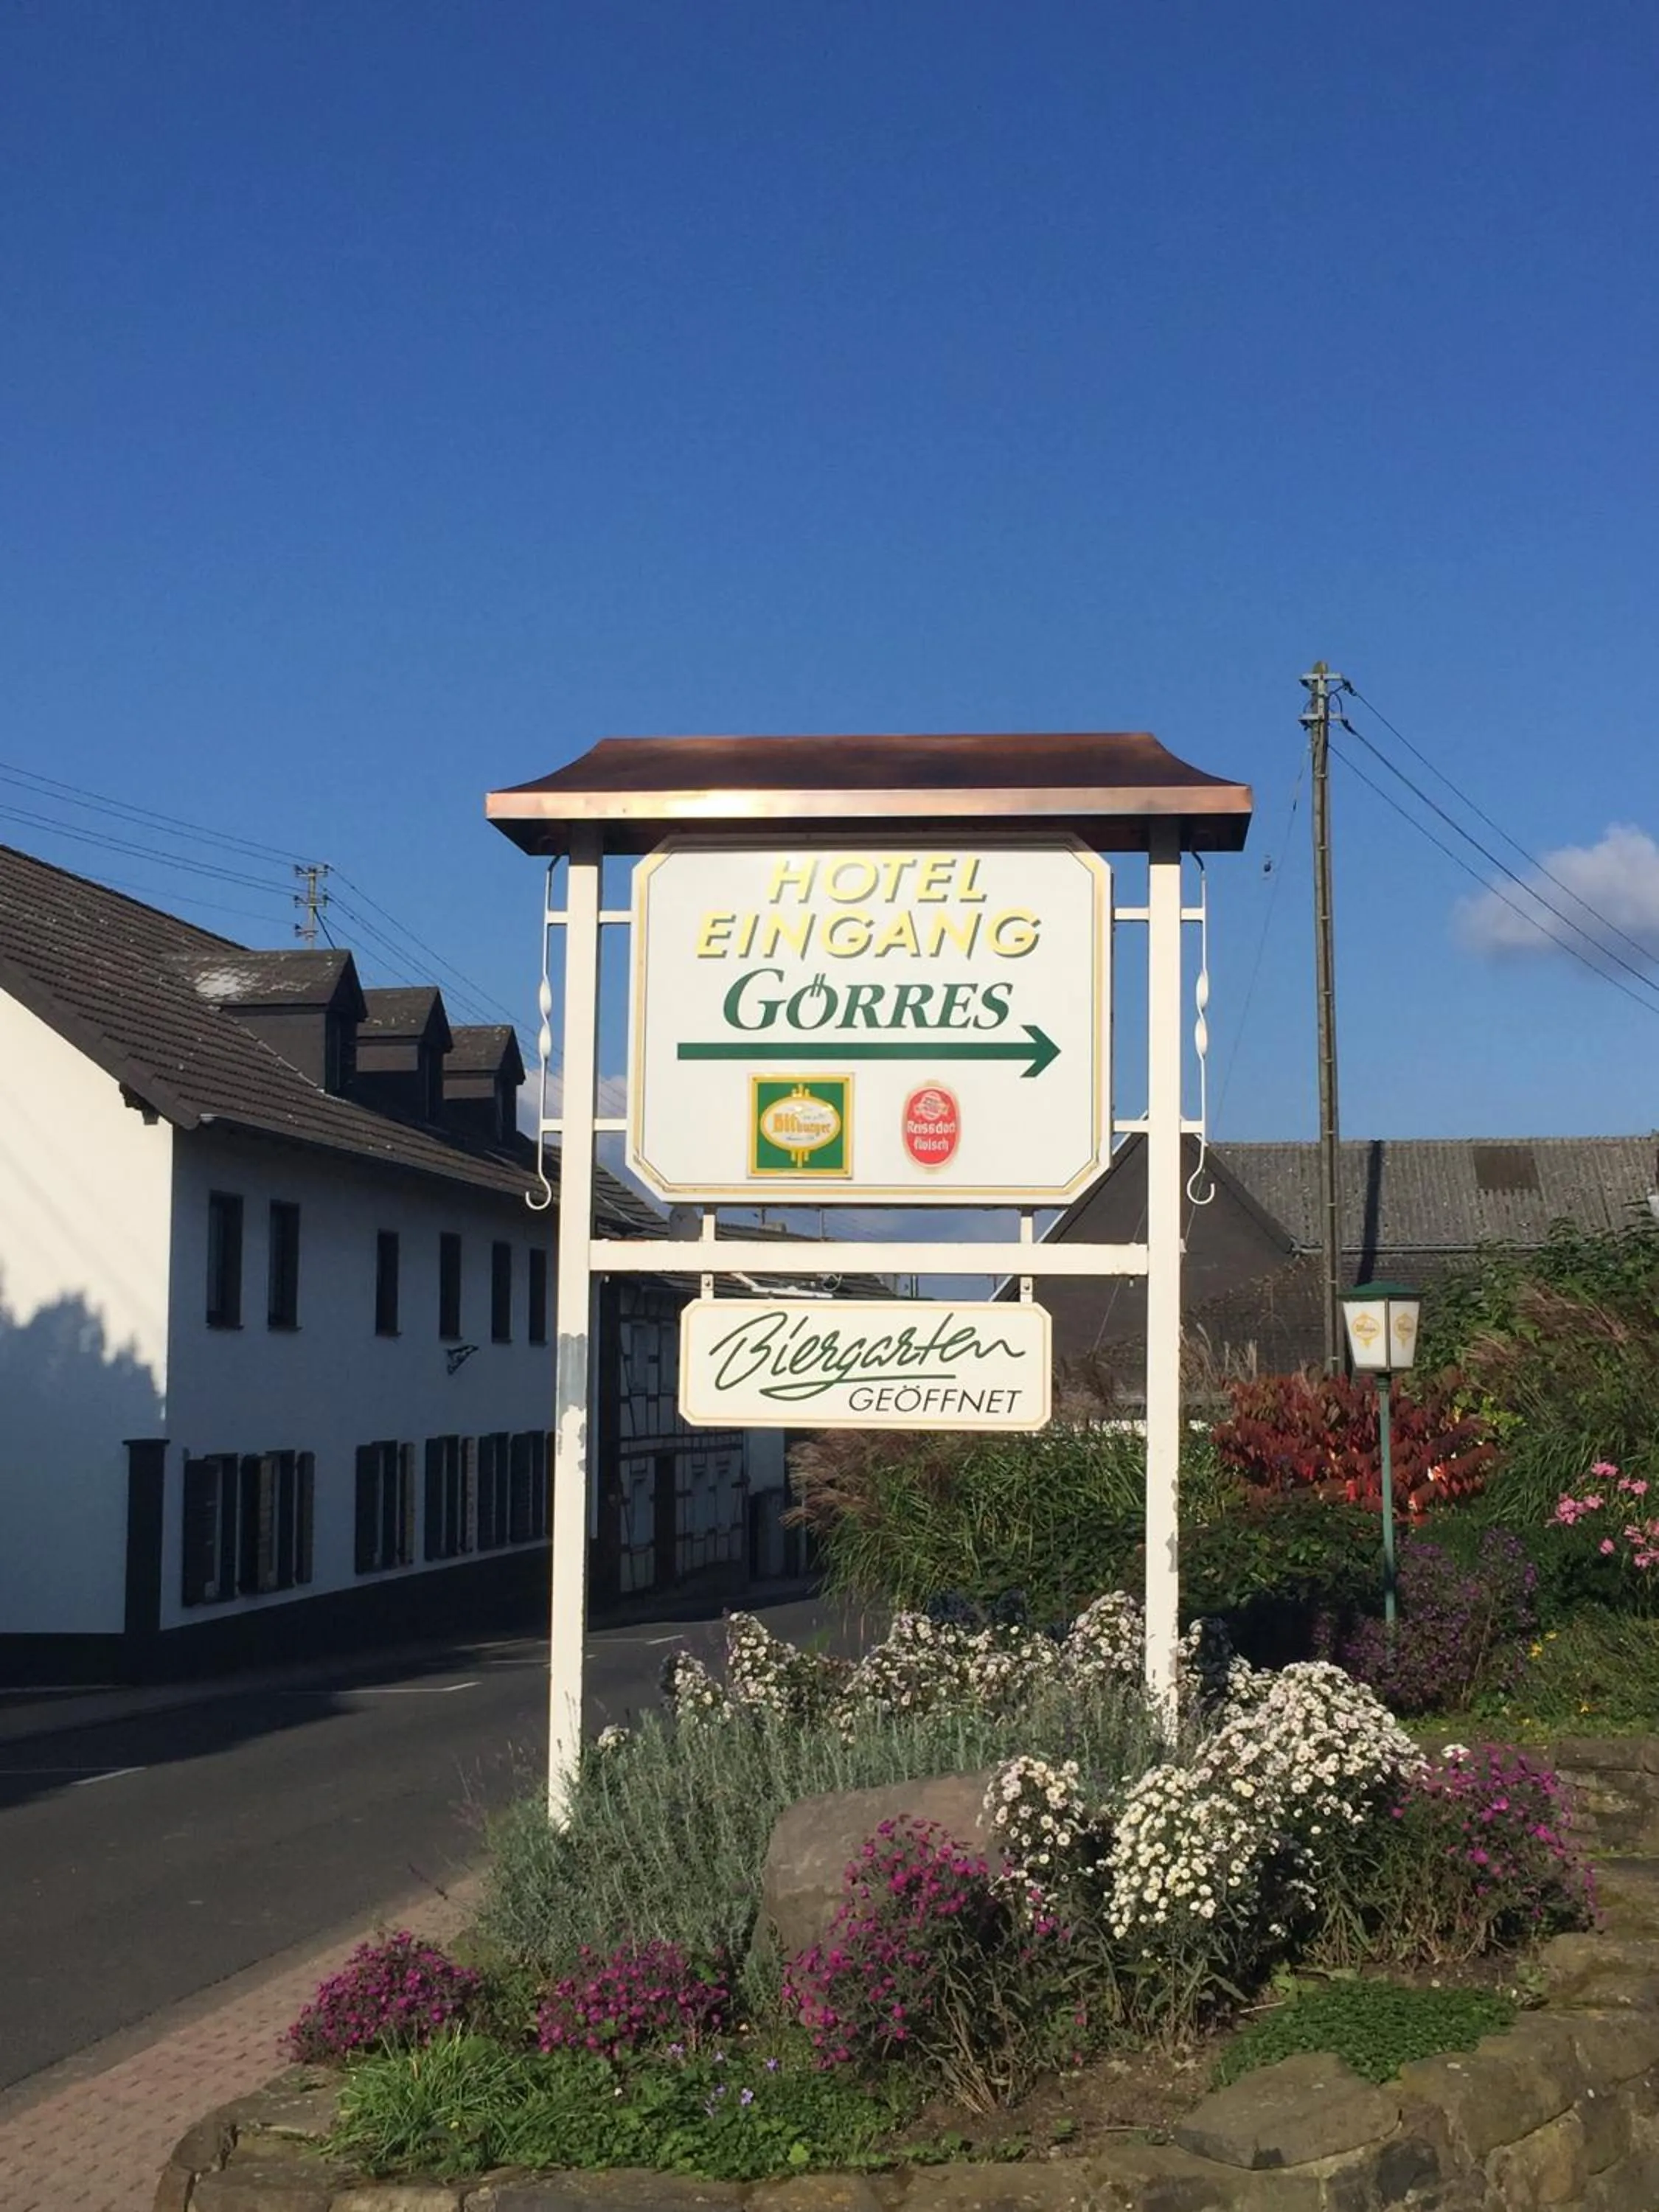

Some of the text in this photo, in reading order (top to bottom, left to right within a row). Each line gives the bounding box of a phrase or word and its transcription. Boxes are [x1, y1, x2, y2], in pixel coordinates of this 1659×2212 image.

[768, 852, 988, 904] HOTEL
[697, 908, 1042, 960] EINGANG
[723, 968, 1013, 1031] GÖRRES
[709, 1312, 1026, 1401] Biergarten
[848, 1384, 1023, 1414] GEÖFFNET
